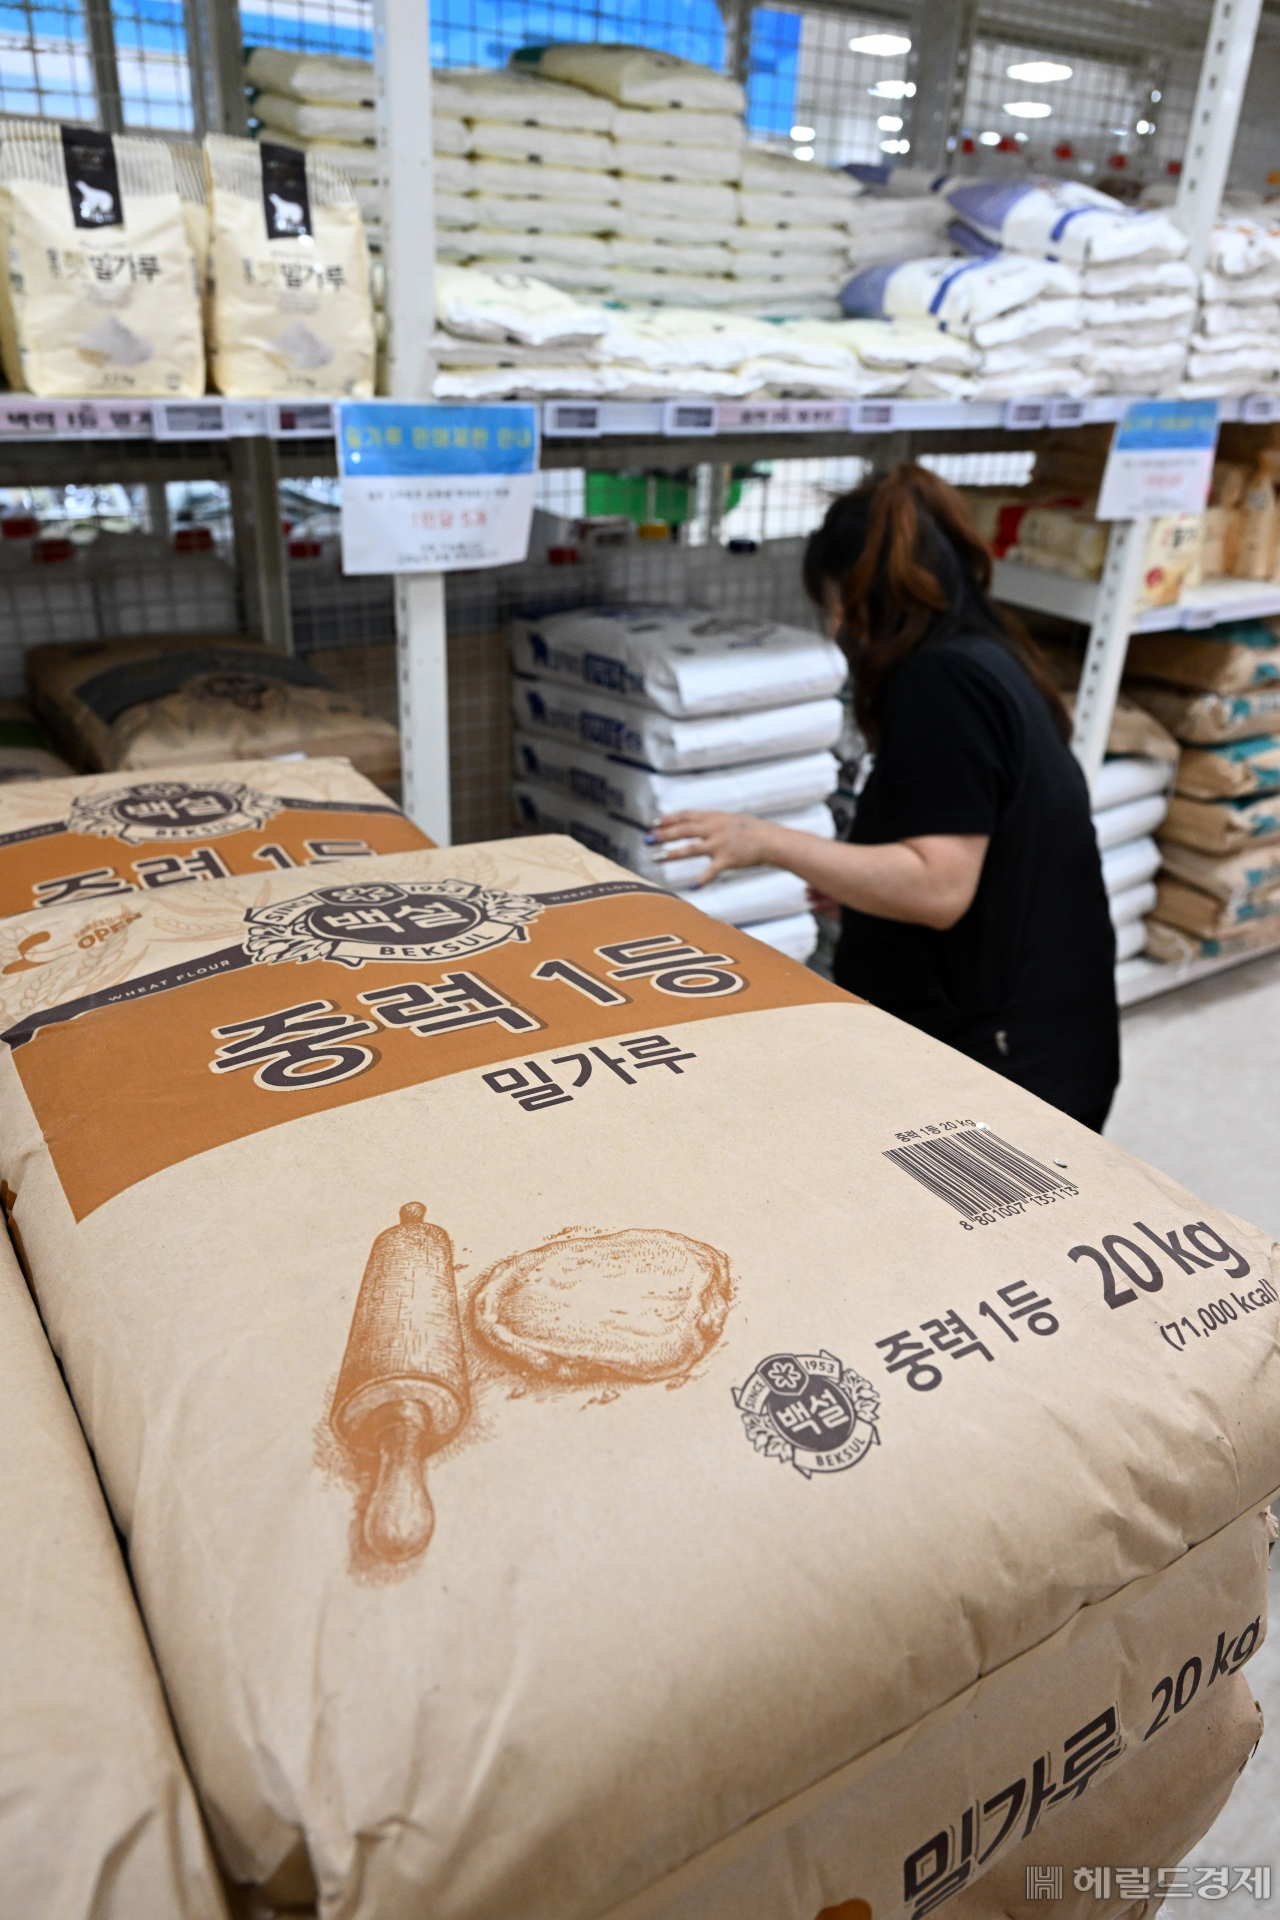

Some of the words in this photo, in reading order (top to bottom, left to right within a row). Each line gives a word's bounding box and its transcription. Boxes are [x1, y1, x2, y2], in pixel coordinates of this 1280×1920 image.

[323, 901, 469, 934] 백설
[379, 932, 496, 958] BEKSUL
[107, 979, 169, 1002] WHEAT
[176, 959, 231, 981] FLOUR
[209, 971, 545, 1093] 중력
[531, 934, 745, 1007] 1등
[481, 1034, 698, 1112] 밀가루
[894, 1128, 922, 1143] 중력
[919, 1124, 942, 1137] 1등
[938, 1120, 959, 1132] 20
[954, 1118, 977, 1128] kg
[958, 1219, 975, 1232] 8
[974, 1201, 1028, 1227] 801007
[1028, 1185, 1080, 1207] 135113
[874, 1308, 995, 1392] 중력
[978, 1279, 1060, 1343] 1등
[1067, 1234, 1164, 1310] 20
[1132, 1220, 1251, 1279] kg
[1159, 1298, 1239, 1352] (71,000
[1229, 1277, 1279, 1315] kcal)
[744, 1379, 767, 1409] SINCE
[804, 1359, 836, 1374] 1953
[775, 1388, 850, 1436] 백설
[815, 1437, 866, 1467] BEKSUL
[903, 1705, 1123, 1920] 밀가루
[1143, 1656, 1202, 1742] 20
[1206, 1614, 1261, 1688] kg
